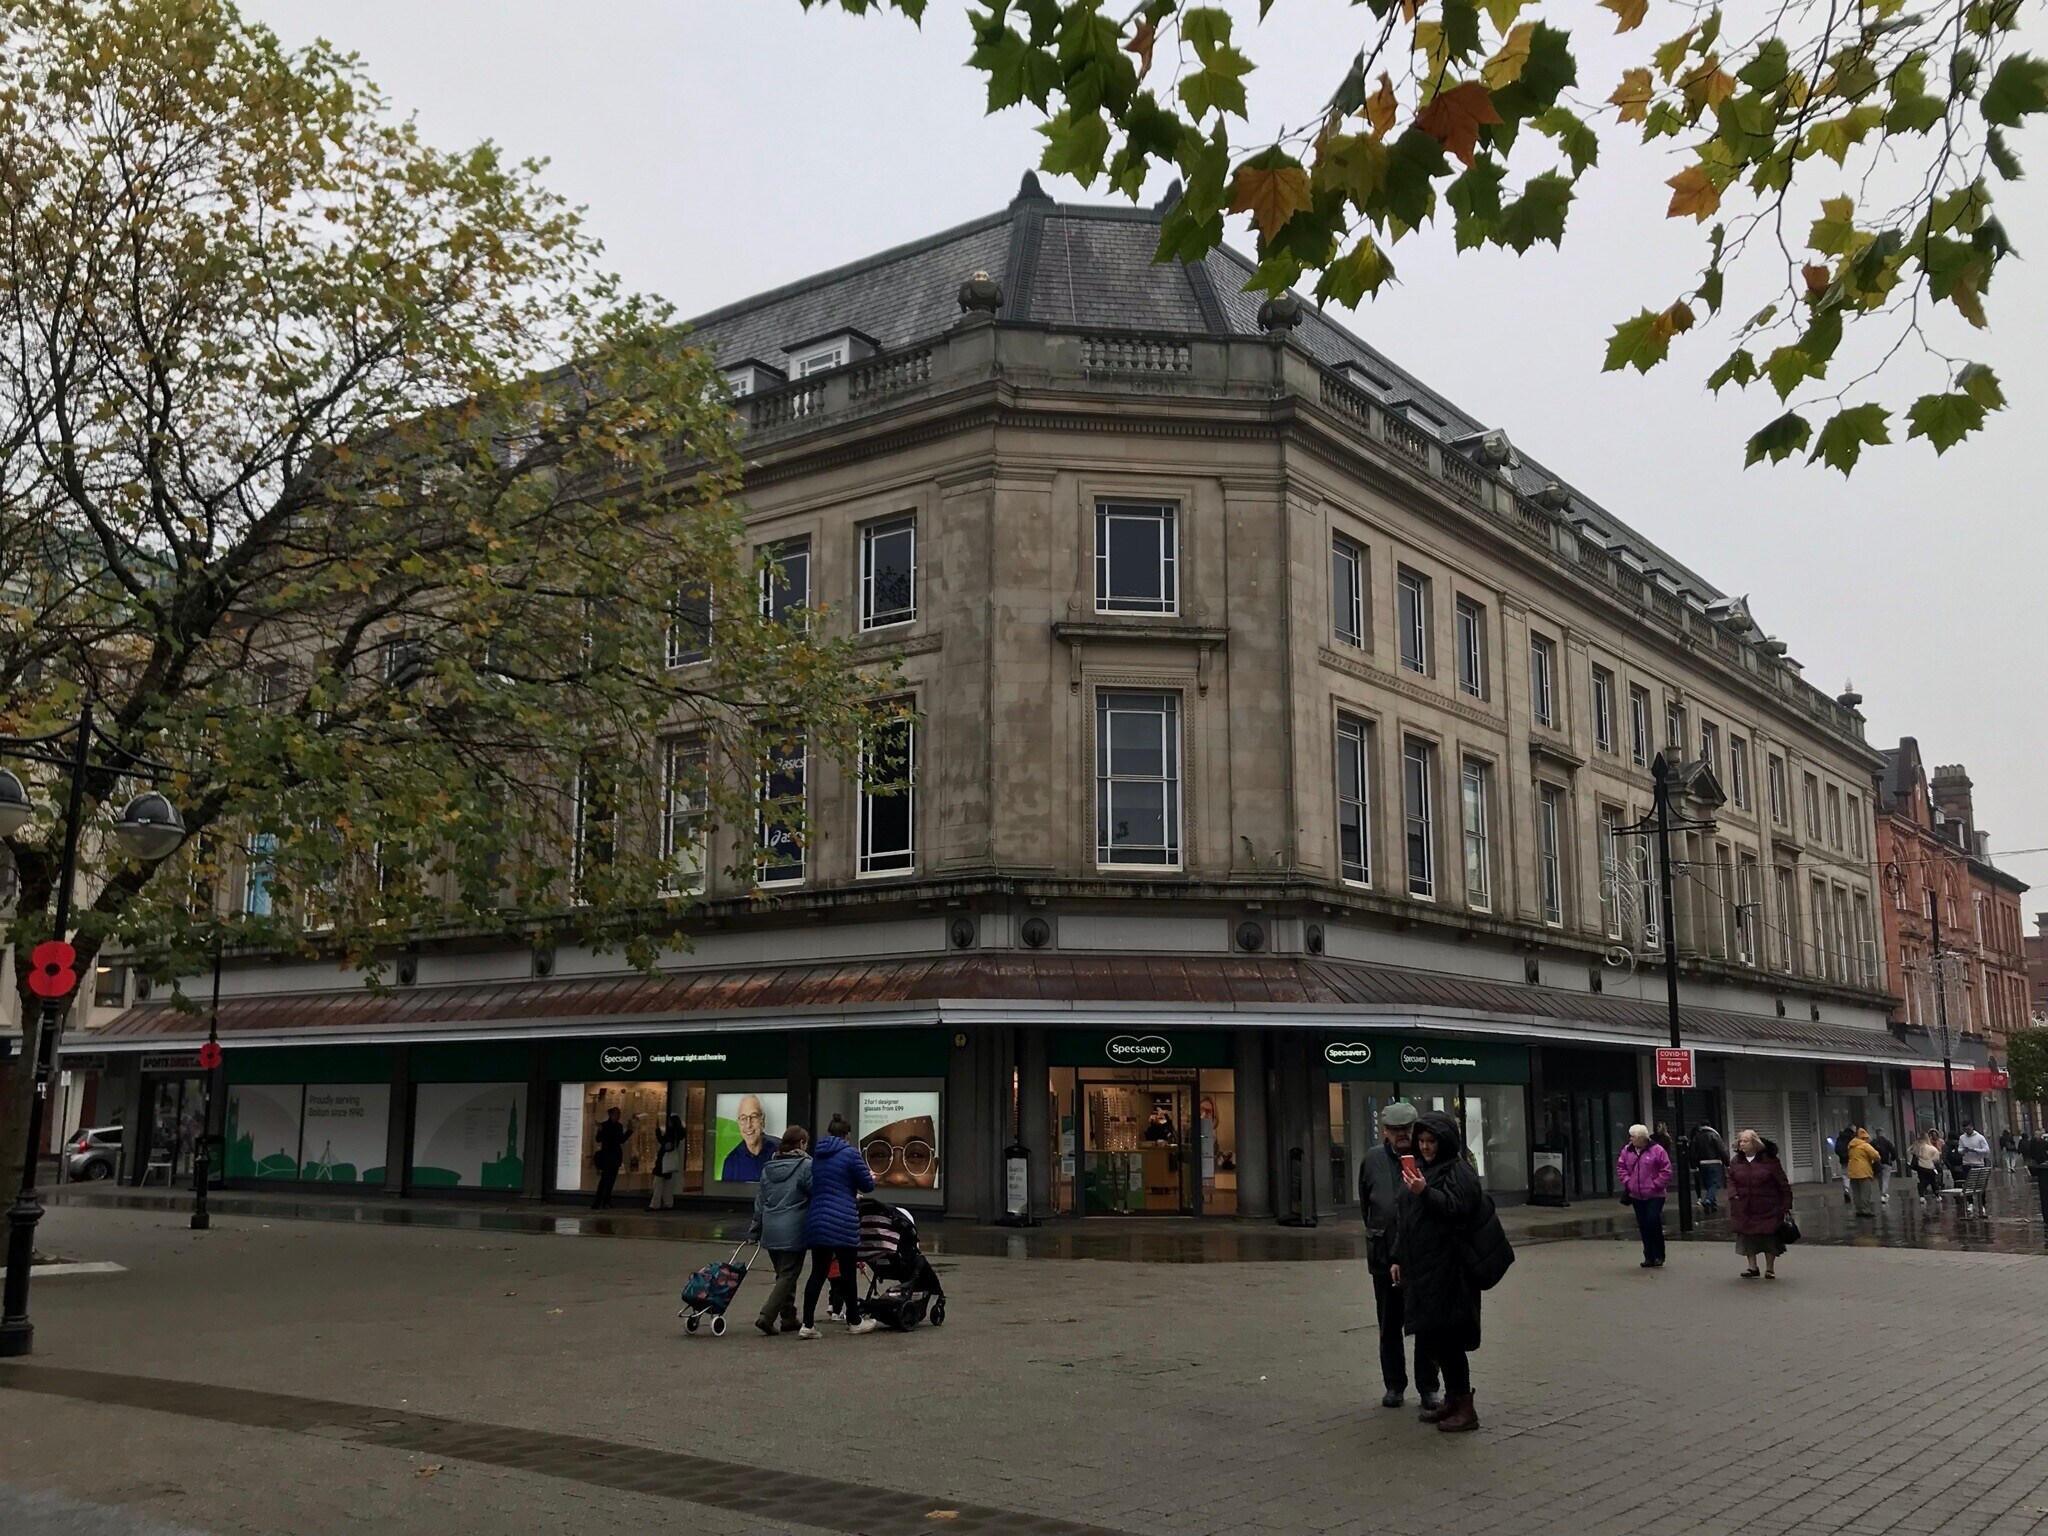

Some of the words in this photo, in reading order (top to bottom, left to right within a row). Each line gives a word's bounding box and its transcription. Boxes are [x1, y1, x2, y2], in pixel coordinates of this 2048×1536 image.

[1112, 1044, 1166, 1055] Specsavers
[1329, 1049, 1367, 1058] Specsavers
[604, 1055, 637, 1064] Specsavers
[1403, 1054, 1427, 1064] Specsavers
[309, 1094, 333, 1105] Proudly
[336, 1096, 360, 1106] serving
[309, 1107, 329, 1117] Bolton
[331, 1107, 347, 1117] since
